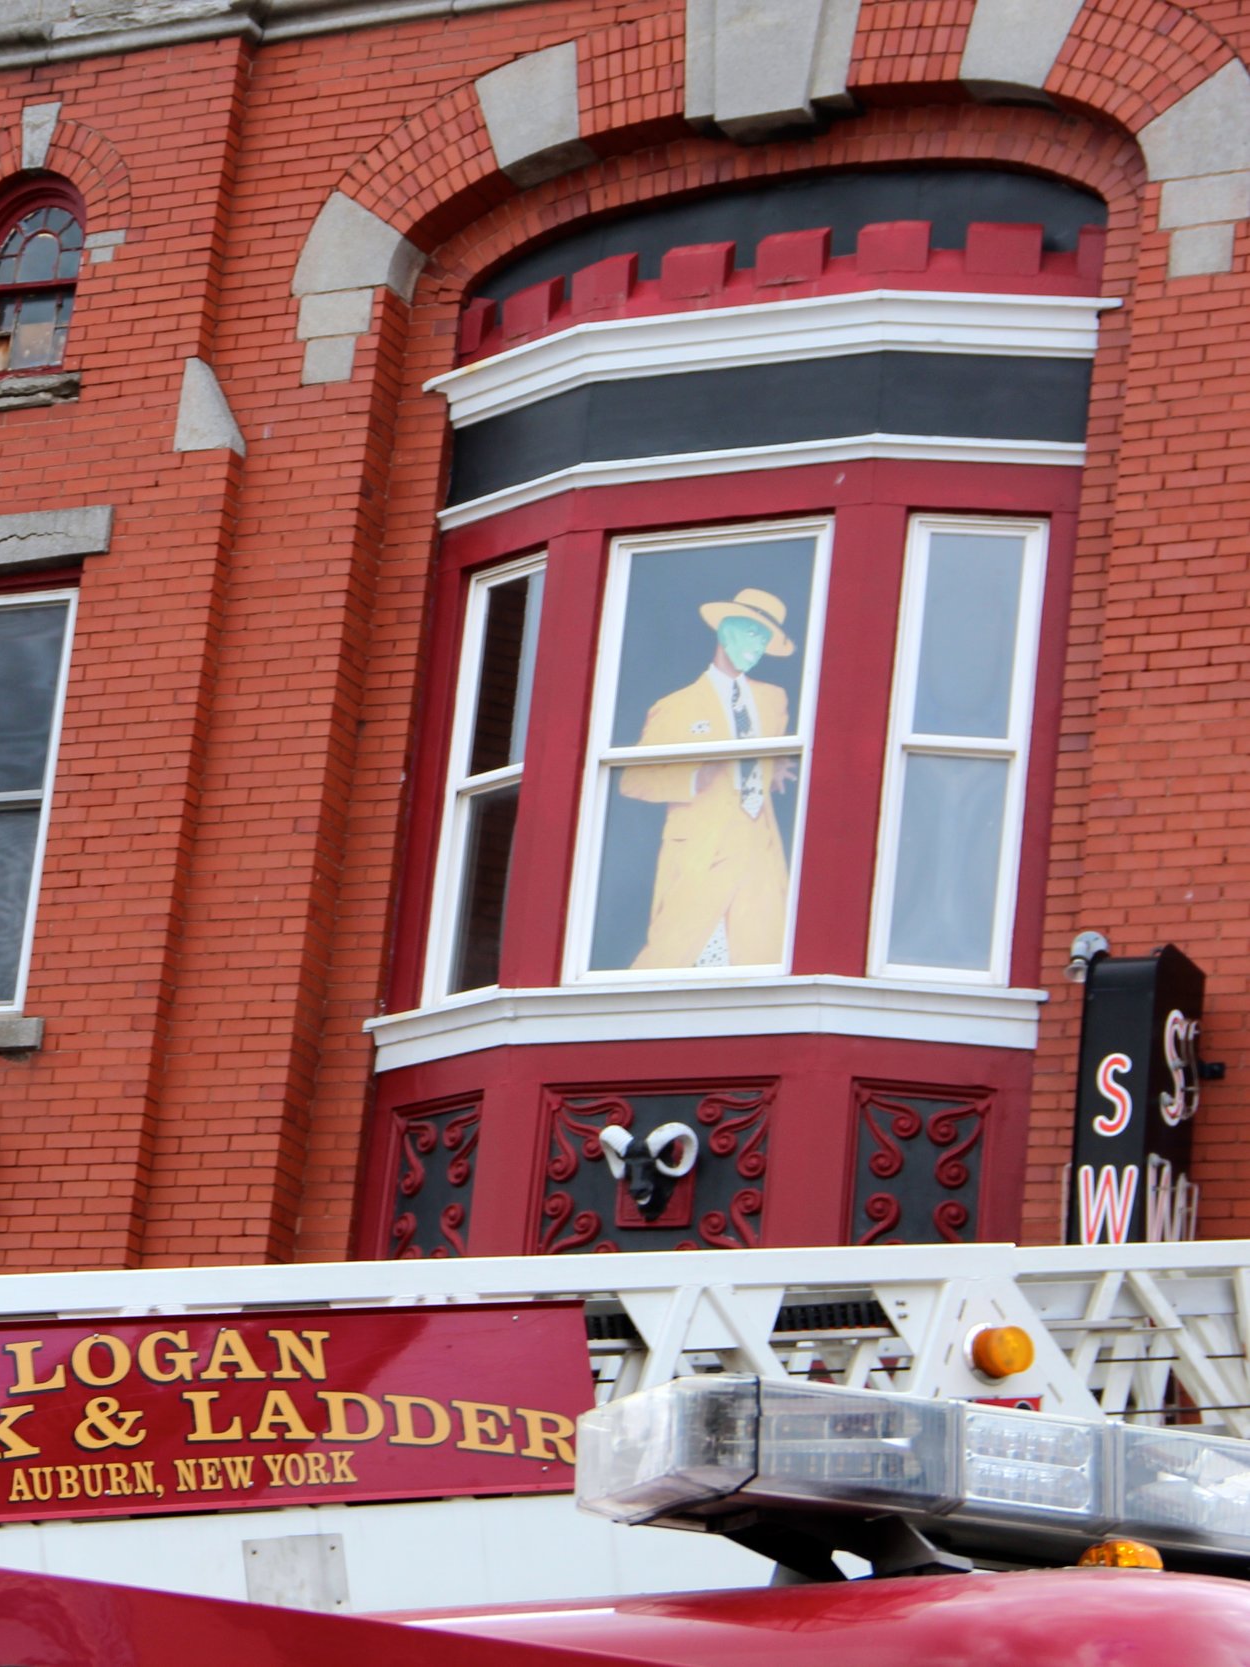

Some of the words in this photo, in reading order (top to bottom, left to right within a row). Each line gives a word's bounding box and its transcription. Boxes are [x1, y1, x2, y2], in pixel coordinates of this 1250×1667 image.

[5, 1329, 330, 1394] LOGAN
[74, 1396, 147, 1449] &
[182, 1390, 576, 1464] LADDER
[8, 1461, 164, 1502] AUBURN,
[173, 1455, 254, 1492] NEW
[263, 1451, 358, 1488] YORK
